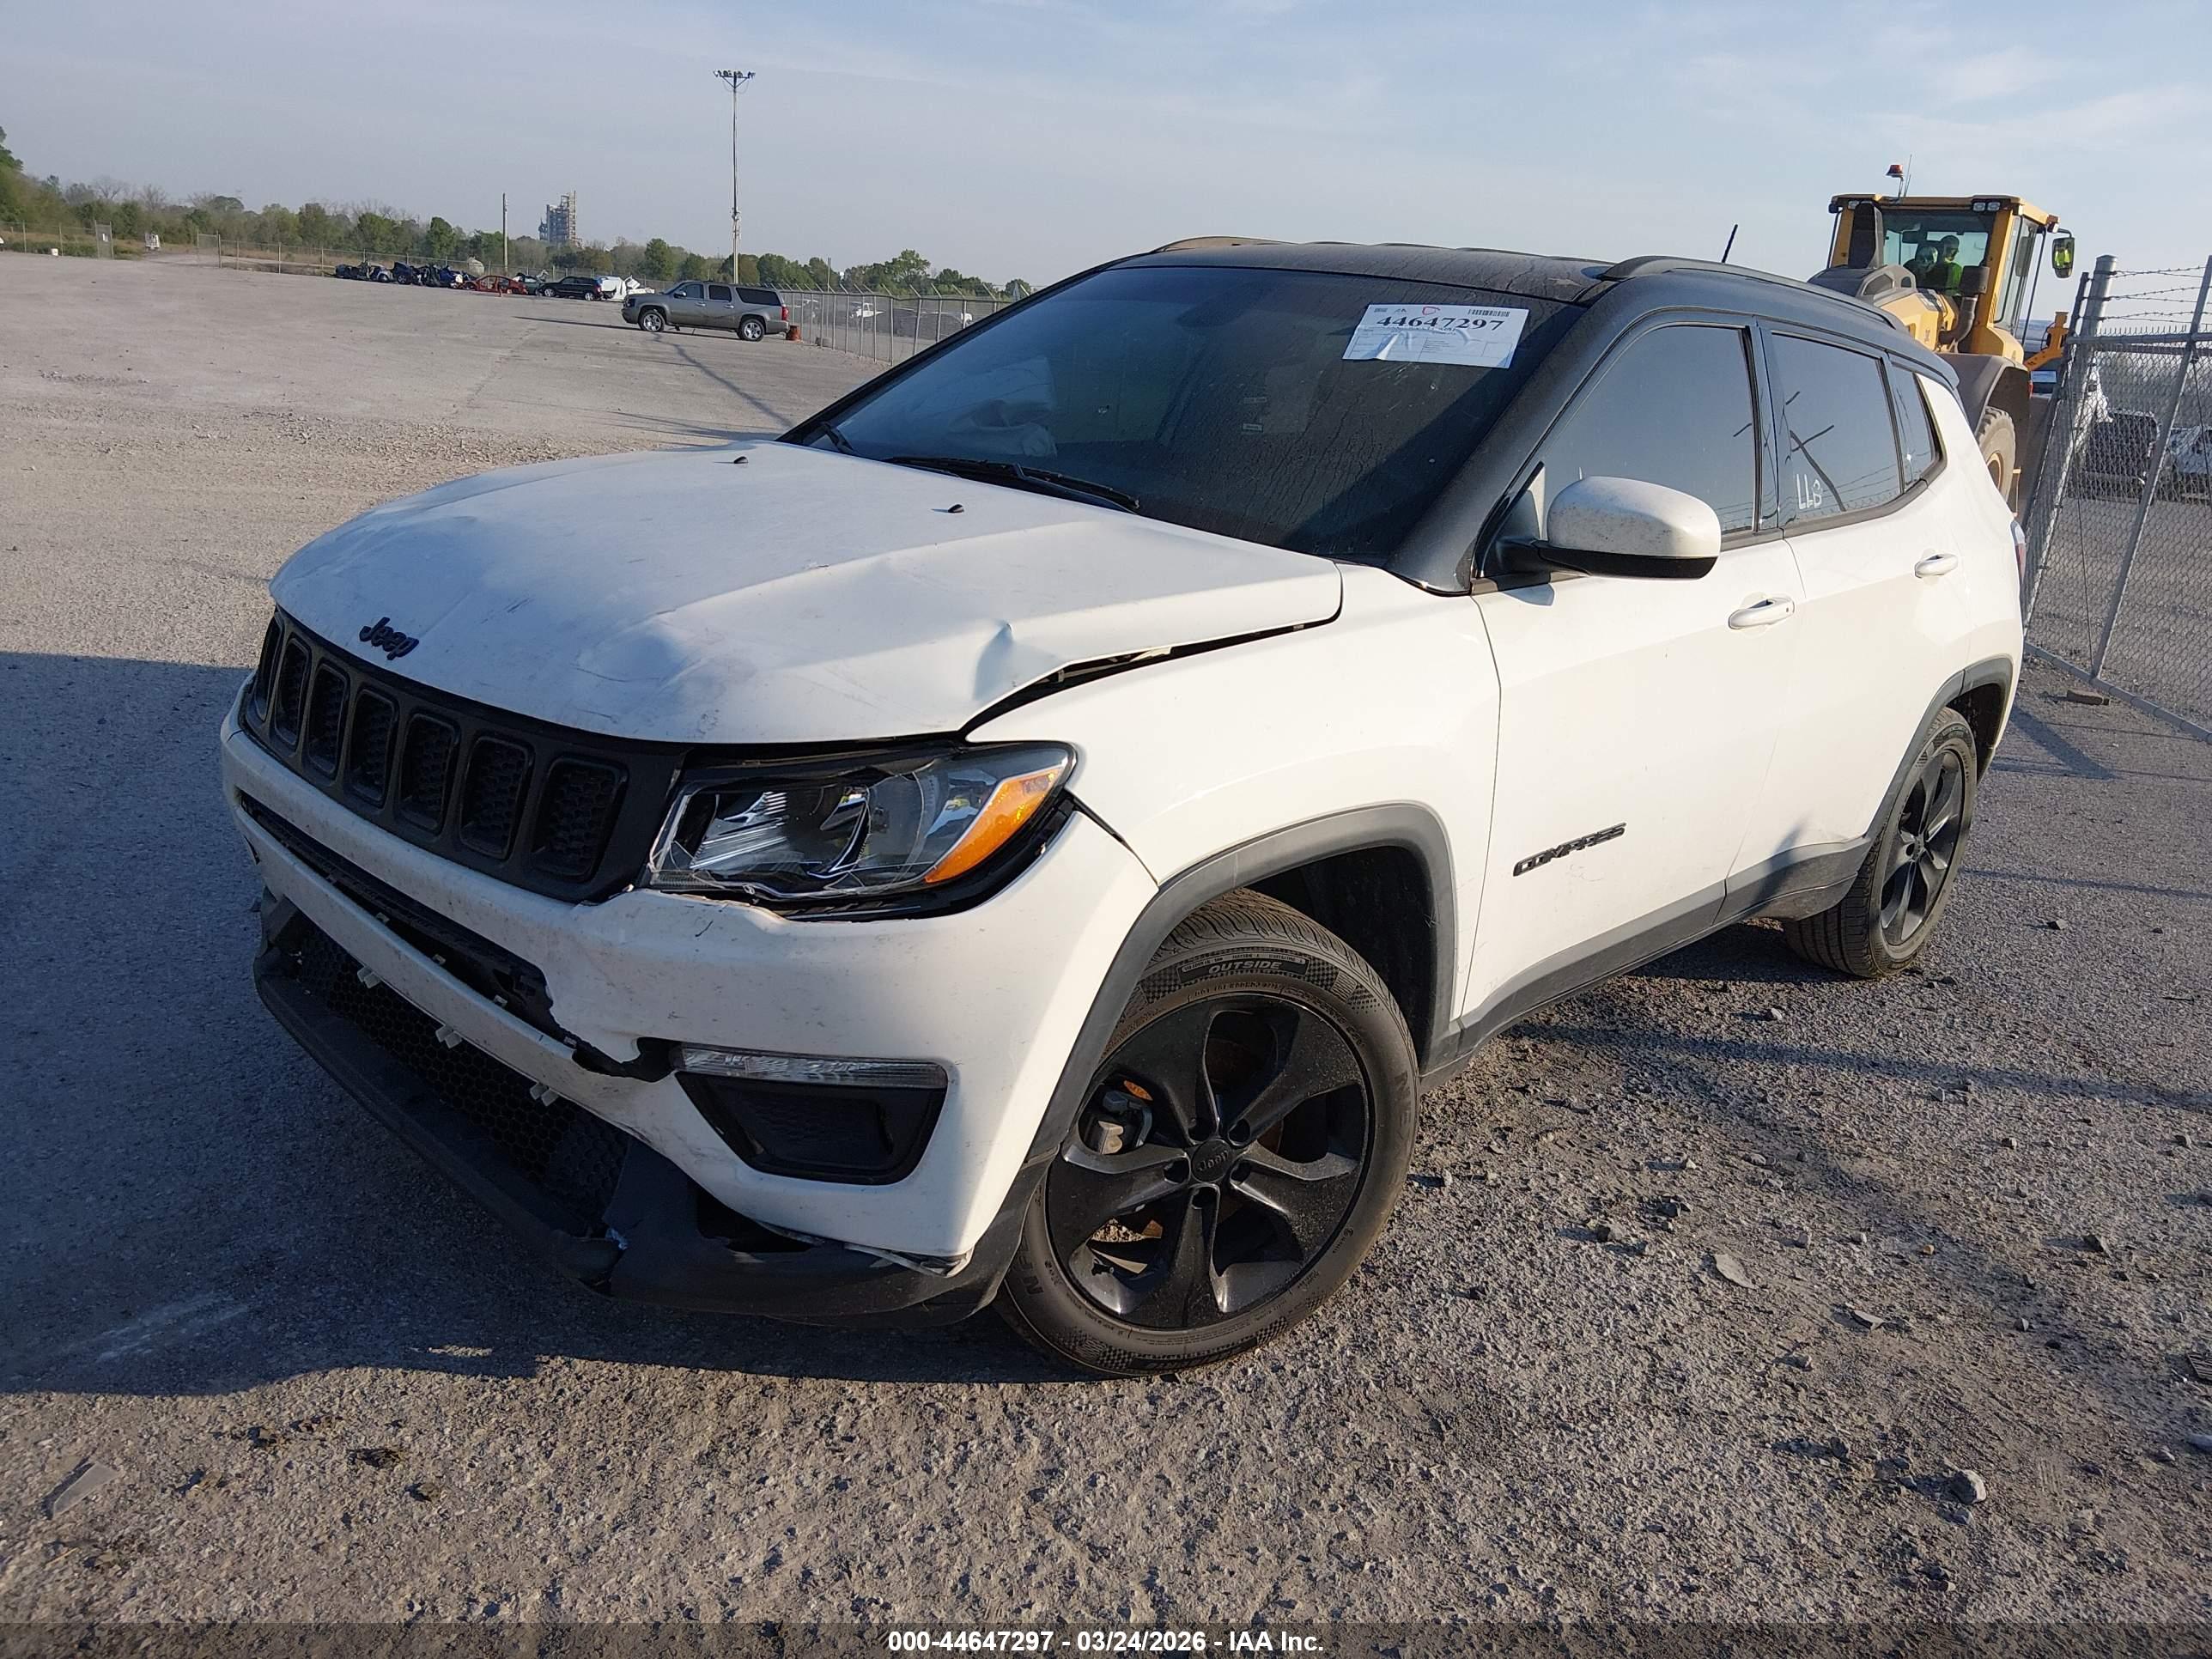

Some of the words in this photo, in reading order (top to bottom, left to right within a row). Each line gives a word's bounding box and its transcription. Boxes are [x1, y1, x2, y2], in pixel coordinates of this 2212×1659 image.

[1376, 315, 1505, 331] 44647297
[359, 617, 419, 660] Jeep
[1513, 822, 1626, 877] COMPASS
[1208, 960, 1283, 975] OUTSIDE
